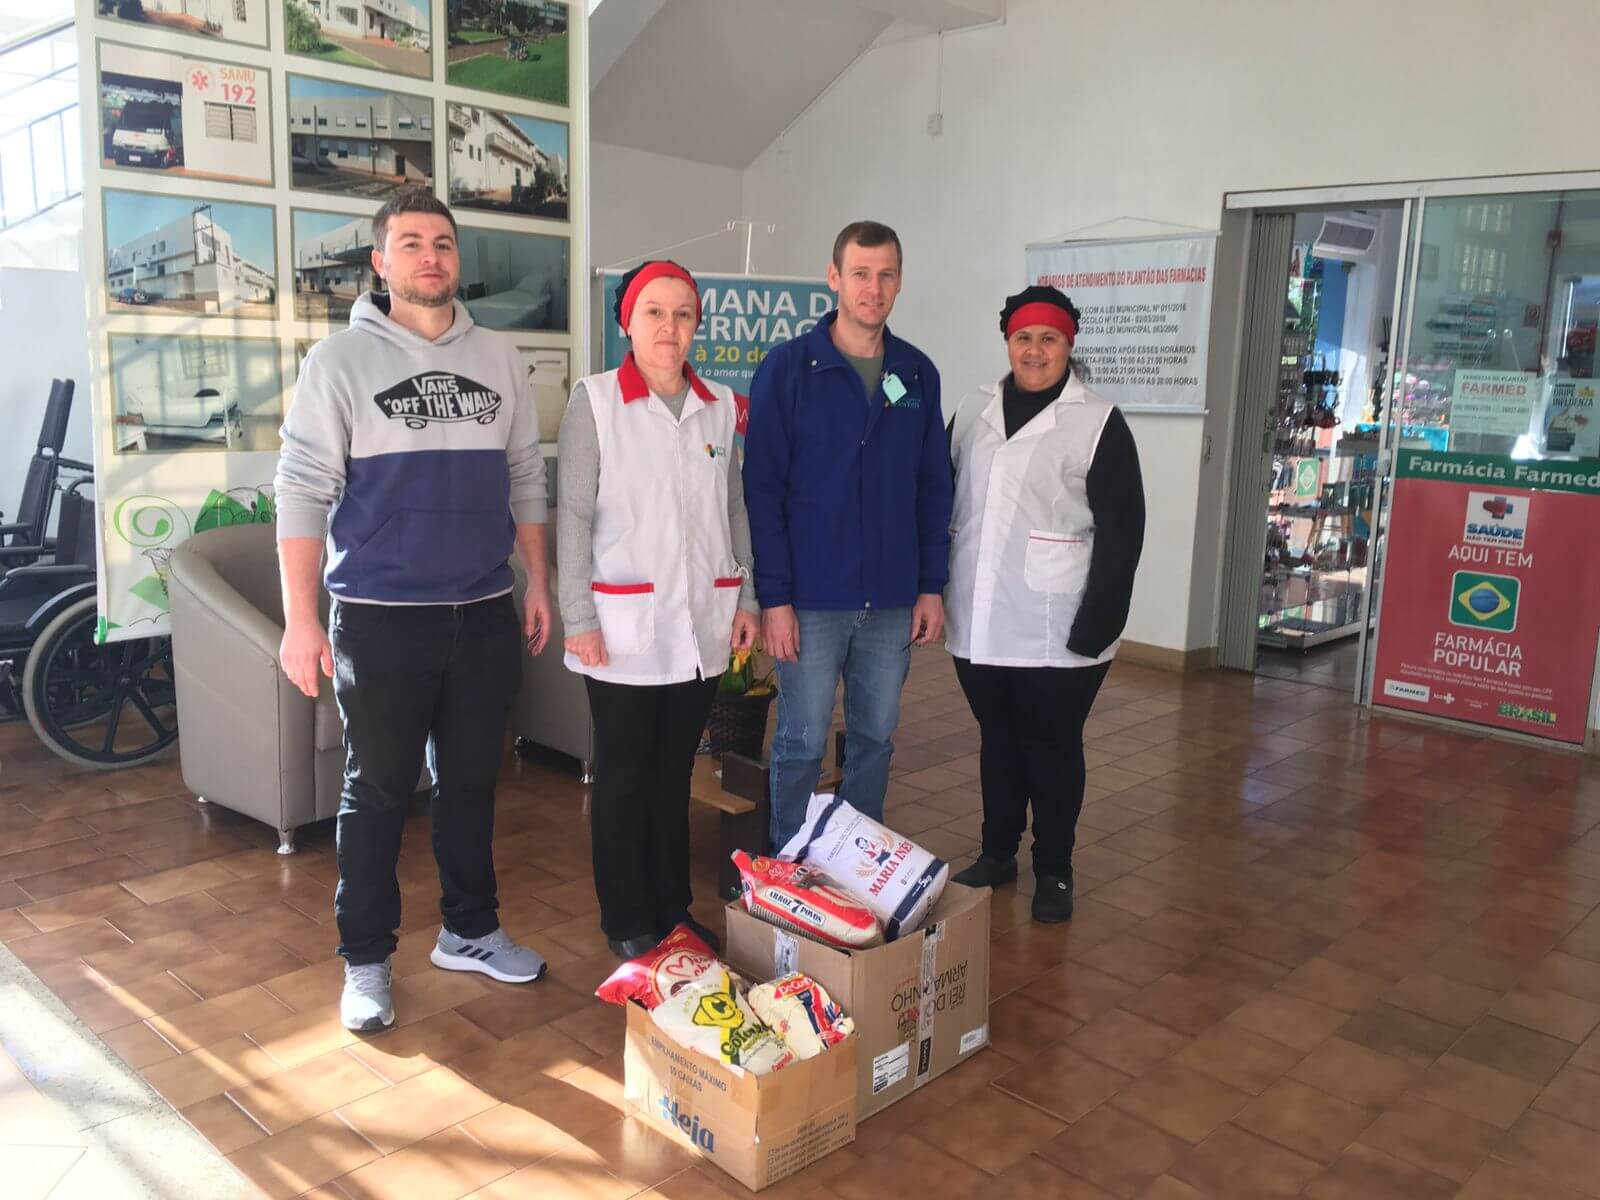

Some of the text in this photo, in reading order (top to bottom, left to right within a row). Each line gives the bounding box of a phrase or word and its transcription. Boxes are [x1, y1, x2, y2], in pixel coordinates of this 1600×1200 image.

[219, 67, 256, 82] SAMU
[221, 83, 256, 105] 192
[1066, 273, 1074, 289] DE
[1075, 271, 1118, 288] ATENDIMENTO
[1118, 271, 1126, 287] DO
[1126, 266, 1155, 286] PLANTÃO
[1155, 267, 1169, 285] DAS
[1169, 264, 1207, 284] FARMÁCIAS
[701, 287, 837, 317] MANA D
[1106, 305, 1115, 314] LEI
[1116, 303, 1152, 313] MUNICIPAL
[1106, 326, 1115, 335] LEI
[1116, 324, 1152, 334] MUNICIPAL
[713, 345, 741, 363] 20
[1118, 345, 1136, 354] APÓS
[1137, 346, 1159, 354] ESSES
[1160, 345, 1197, 354] HORÁRIOS
[1163, 355, 1188, 365] HORAS
[713, 369, 739, 377] amor
[1136, 366, 1160, 375] HORAS
[1173, 376, 1199, 386] HORAS
[411, 375, 460, 396] VANS
[1461, 381, 1528, 397] FARMED
[421, 393, 458, 418] THE
[1408, 456, 1600, 488] Farmácia Farmed
[1466, 522, 1524, 540] SAÚDE
[1448, 545, 1534, 569] AQUI TEM
[1434, 632, 1523, 660] FARMÁCIA
[1433, 648, 1522, 677] POPULAR
[1498, 703, 1557, 724] BRASIL
[868, 860, 900, 897] MARIA
[768, 890, 823, 924] ARROZ 7 POVOS
